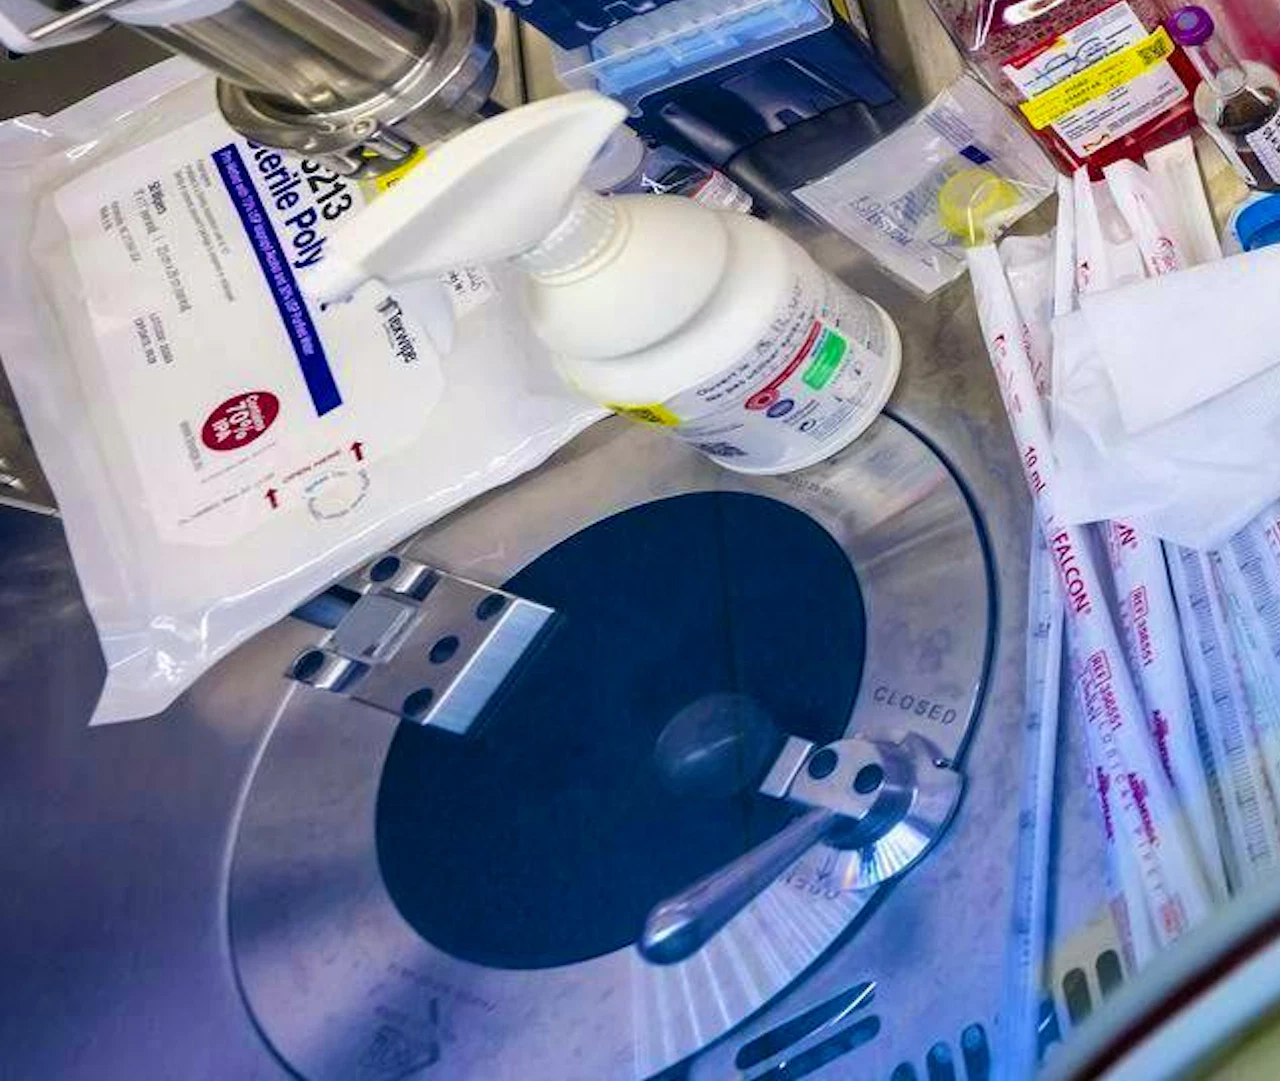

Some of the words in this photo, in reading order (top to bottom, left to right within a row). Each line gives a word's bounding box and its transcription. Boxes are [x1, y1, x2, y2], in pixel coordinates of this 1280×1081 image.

[250, 139, 302, 211] terile
[285, 207, 328, 270] Poly
[211, 418, 232, 443] IPA
[226, 400, 254, 440] 70%
[1024, 446, 1038, 468] 10
[873, 685, 958, 726] CLOSED
